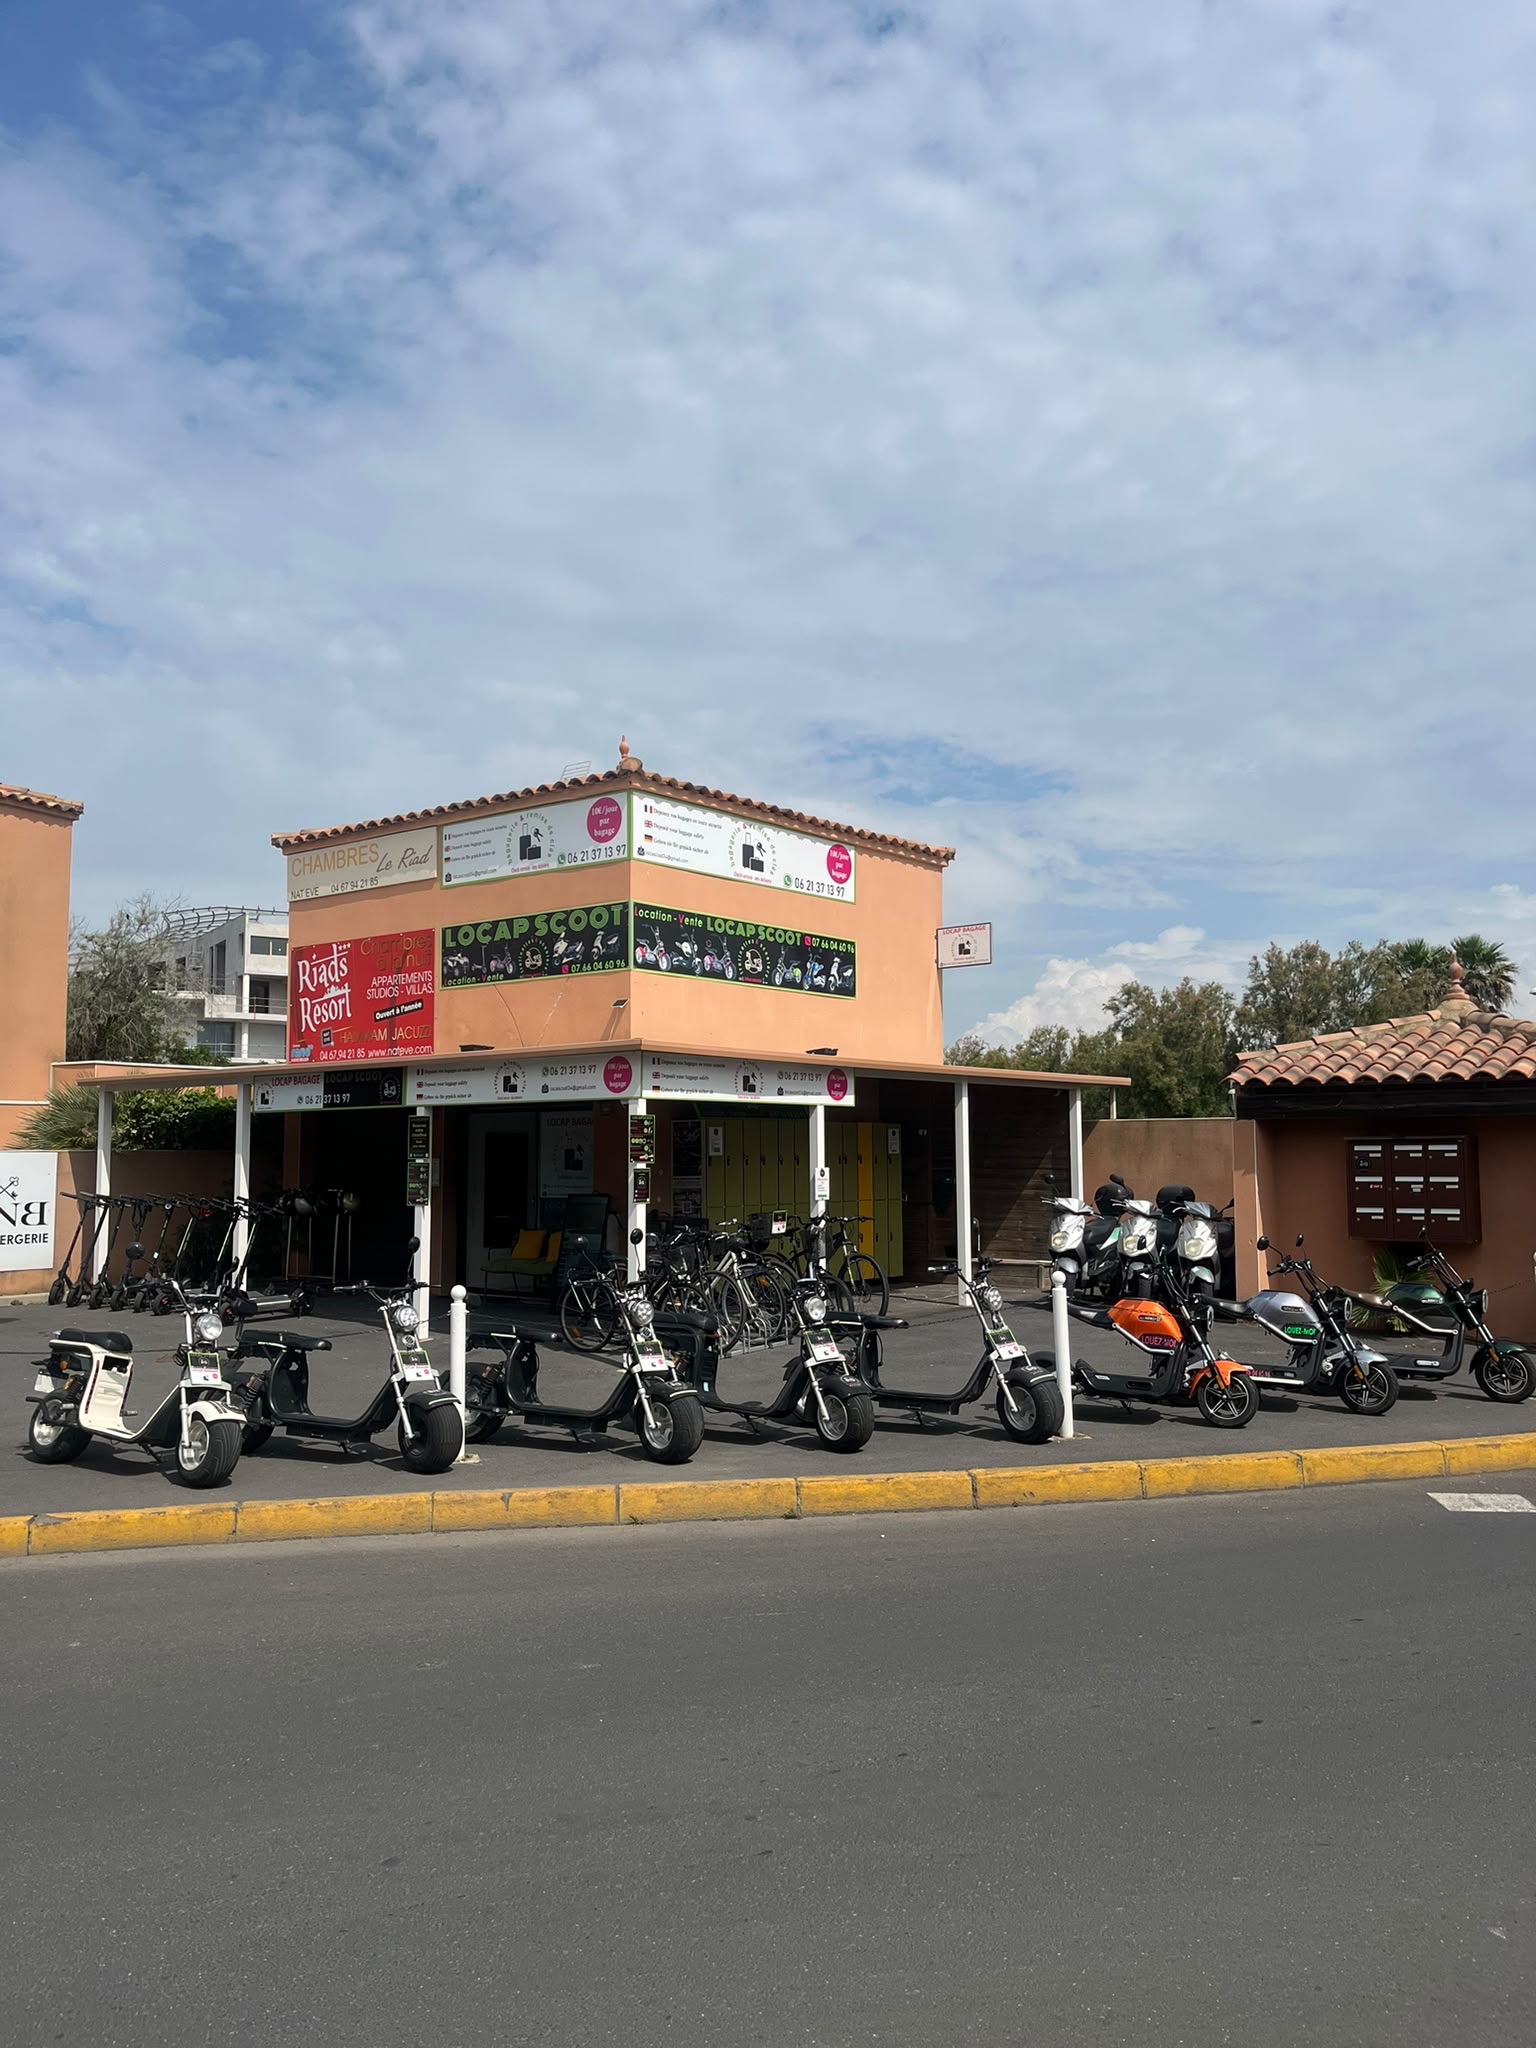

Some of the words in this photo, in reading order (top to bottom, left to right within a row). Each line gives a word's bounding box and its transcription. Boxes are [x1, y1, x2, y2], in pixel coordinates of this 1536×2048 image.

[599, 817, 610, 827] par
[594, 827, 615, 837] bagage
[291, 843, 379, 877] CHAMBRES
[376, 853, 392, 873] Le
[398, 845, 433, 870] Riad
[567, 852, 578, 864] 06
[581, 850, 589, 862] 21
[591, 848, 601, 860] 37
[605, 846, 613, 858] 13
[616, 844, 626, 856] 97
[290, 889, 304, 899] NAT
[305, 887, 319, 897] EVE
[331, 884, 339, 893] 04
[341, 882, 349, 891] 67
[350, 880, 359, 890] 94
[360, 879, 368, 889] 21
[370, 876, 379, 887] 85
[795, 877, 804, 889] 06
[806, 880, 814, 891] 21
[816, 882, 825, 893] 37
[827, 884, 834, 896] 13
[836, 886, 845, 897] 97
[445, 917, 529, 948] LOCAP
[534, 904, 623, 937] SCOOT
[634, 906, 672, 922] Location
[678, 914, 703, 927] Vente
[706, 917, 755, 937] LOCAP
[758, 926, 801, 945] SCOOT
[812, 938, 820, 947] 07
[821, 939, 829, 947] 66
[830, 941, 838, 950] 04
[839, 943, 846, 952] 60
[847, 944, 854, 953] 96
[297, 944, 348, 993] Riads
[571, 963, 581, 973] 07
[582, 963, 591, 972] 66
[593, 962, 603, 970] 04
[604, 960, 614, 969] 60
[615, 959, 626, 968] 96
[371, 970, 432, 987] APPARTEMENTS
[444, 975, 476, 986] Location
[482, 973, 504, 983] Vente
[367, 987, 399, 1000] STUDIOS
[299, 983, 352, 1032] Resort
[376, 1010, 395, 1020] Ouvert
[401, 1002, 422, 1013] l'année
[320, 1050, 328, 1060] 04
[329, 1050, 337, 1059] 67
[338, 1049, 346, 1059] 94
[347, 1048, 355, 1058] 21
[356, 1048, 365, 1058] 85
[550, 1067, 558, 1076] 06
[560, 1067, 567, 1075] 21
[568, 1065, 577, 1075] 37
[579, 1065, 586, 1074] 13
[588, 1064, 597, 1074] 97
[272, 1076, 293, 1087] LOCAP
[294, 1075, 320, 1085] BAGAGE
[785, 1072, 791, 1081] 06
[793, 1072, 799, 1081] 21
[800, 1073, 806, 1081] 37
[808, 1073, 814, 1081] 13
[815, 1073, 822, 1082] 97
[305, 1095, 313, 1104] 06
[315, 1095, 321, 1104] 21
[324, 1095, 332, 1104] 37
[333, 1094, 340, 1103] 13
[342, 1093, 350, 1103] 97
[1284, 1327, 1316, 1336] LOUEZ-MOI
[1142, 1336, 1176, 1348] LOUEZ-MOI
